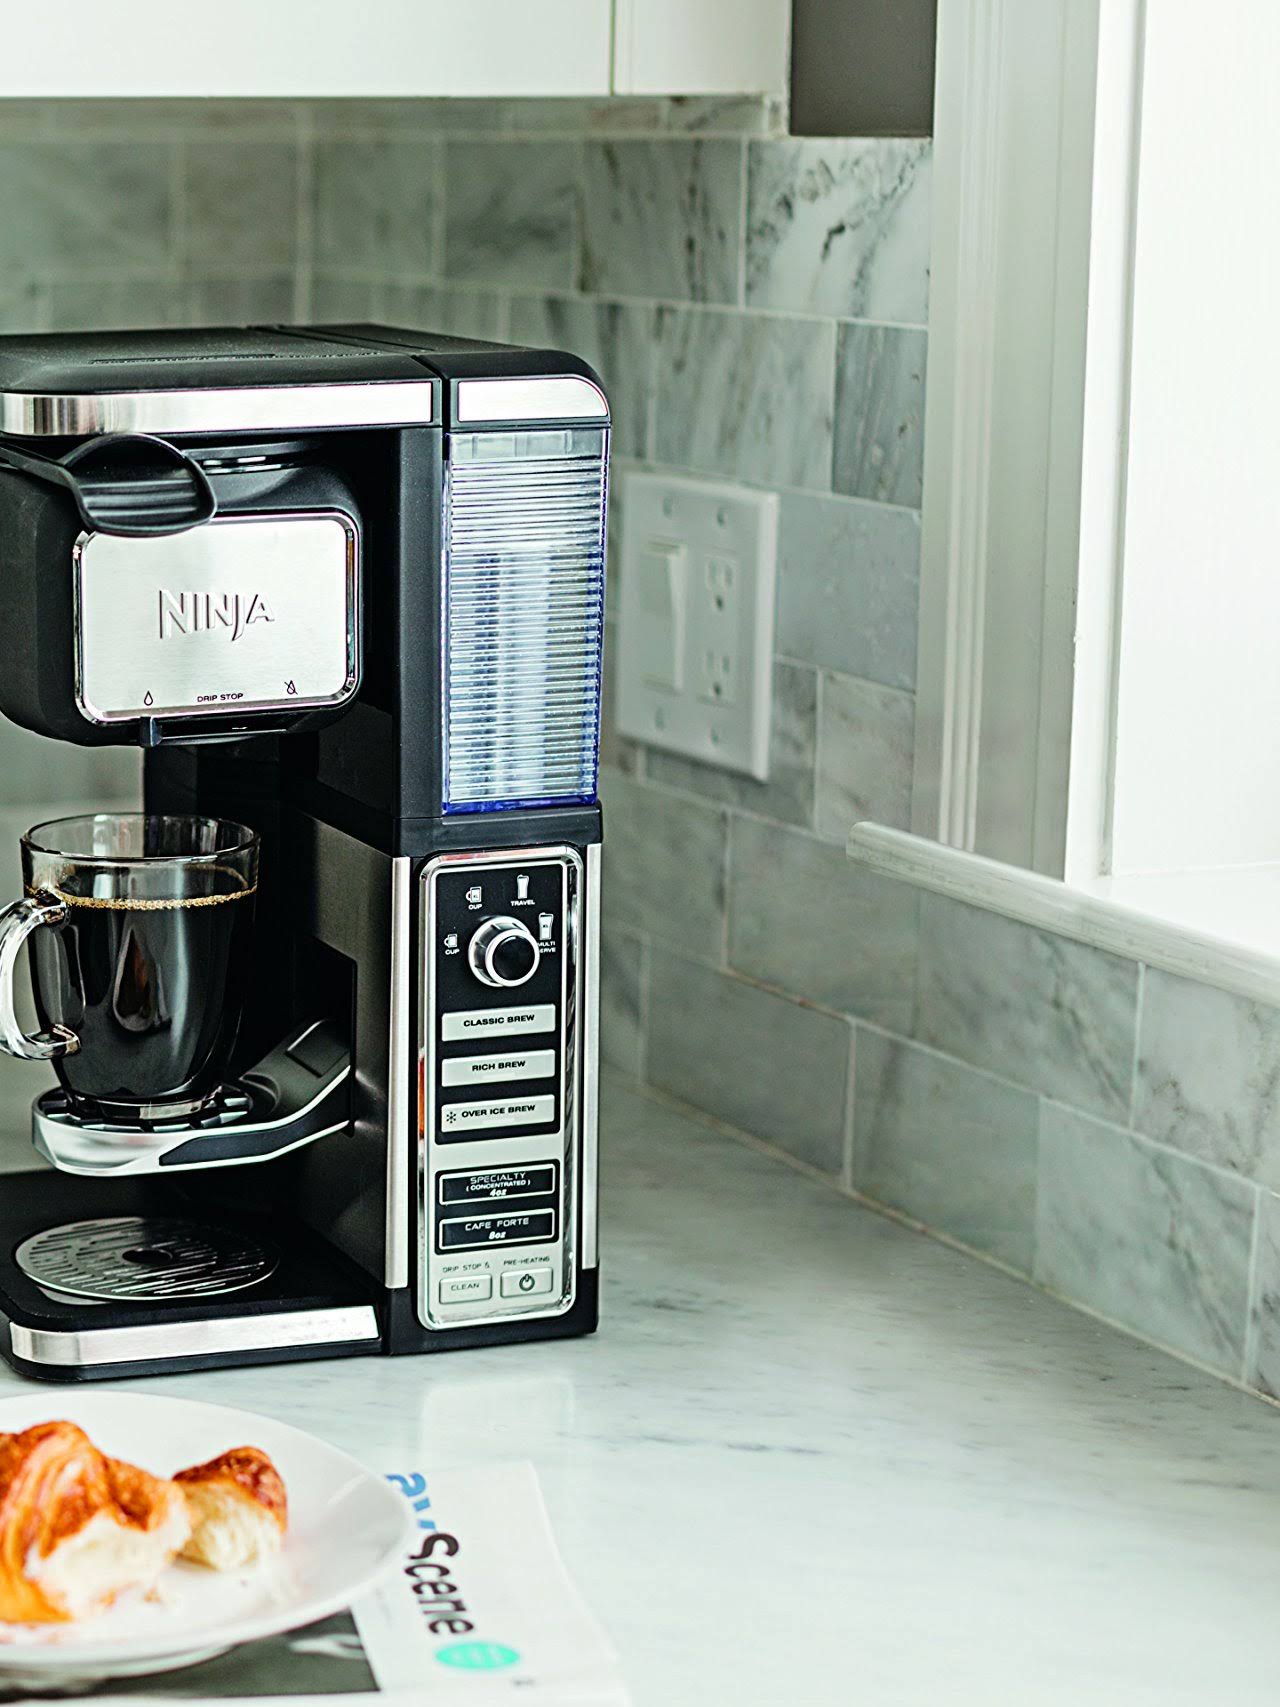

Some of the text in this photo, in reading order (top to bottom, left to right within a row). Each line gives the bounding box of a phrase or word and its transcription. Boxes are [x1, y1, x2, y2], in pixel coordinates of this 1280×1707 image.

[159, 588, 275, 641] NINJA
[197, 692, 244, 703] DRIP STOP
[463, 1014, 535, 1027] CLASSIC BREW
[472, 1060, 526, 1071] RICH BREW
[461, 1104, 536, 1118] OVER ICE BREW
[470, 1172, 526, 1184] SPECIALTY
[465, 1217, 530, 1231] CAFE FORTE
[503, 1255, 550, 1266] PRE-HEATING
[442, 1265, 459, 1273] DRIP
[463, 1262, 481, 1271] STOP
[450, 1282, 480, 1291] CLEAN
